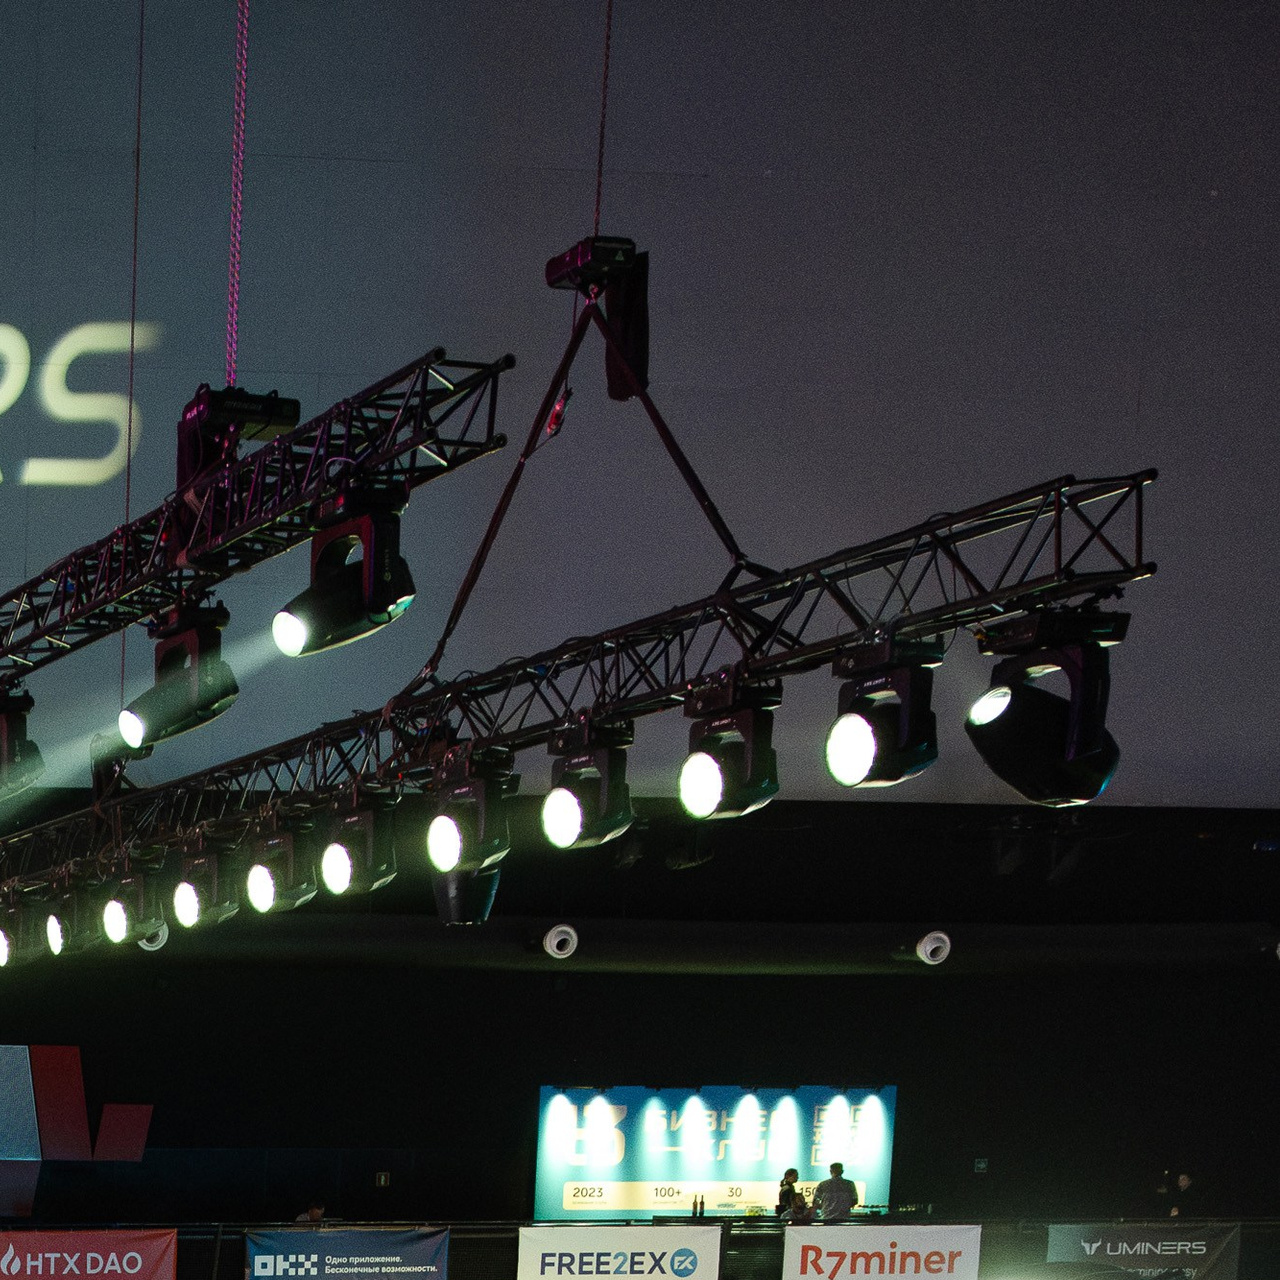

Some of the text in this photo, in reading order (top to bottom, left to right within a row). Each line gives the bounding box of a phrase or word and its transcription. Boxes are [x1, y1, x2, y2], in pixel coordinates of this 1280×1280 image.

[572, 1187, 604, 1198] 2023
[653, 1186, 682, 1198] 100+
[727, 1186, 743, 1198] 30
[1106, 1241, 1207, 1256] UMINERS
[26, 1251, 143, 1276] HTX DAO
[325, 1255, 403, 1266] Одно приложение.
[540, 1251, 668, 1276] FREE2EX
[799, 1241, 963, 1280] R7miner
[325, 1264, 439, 1274] Бесконечные возможности.
